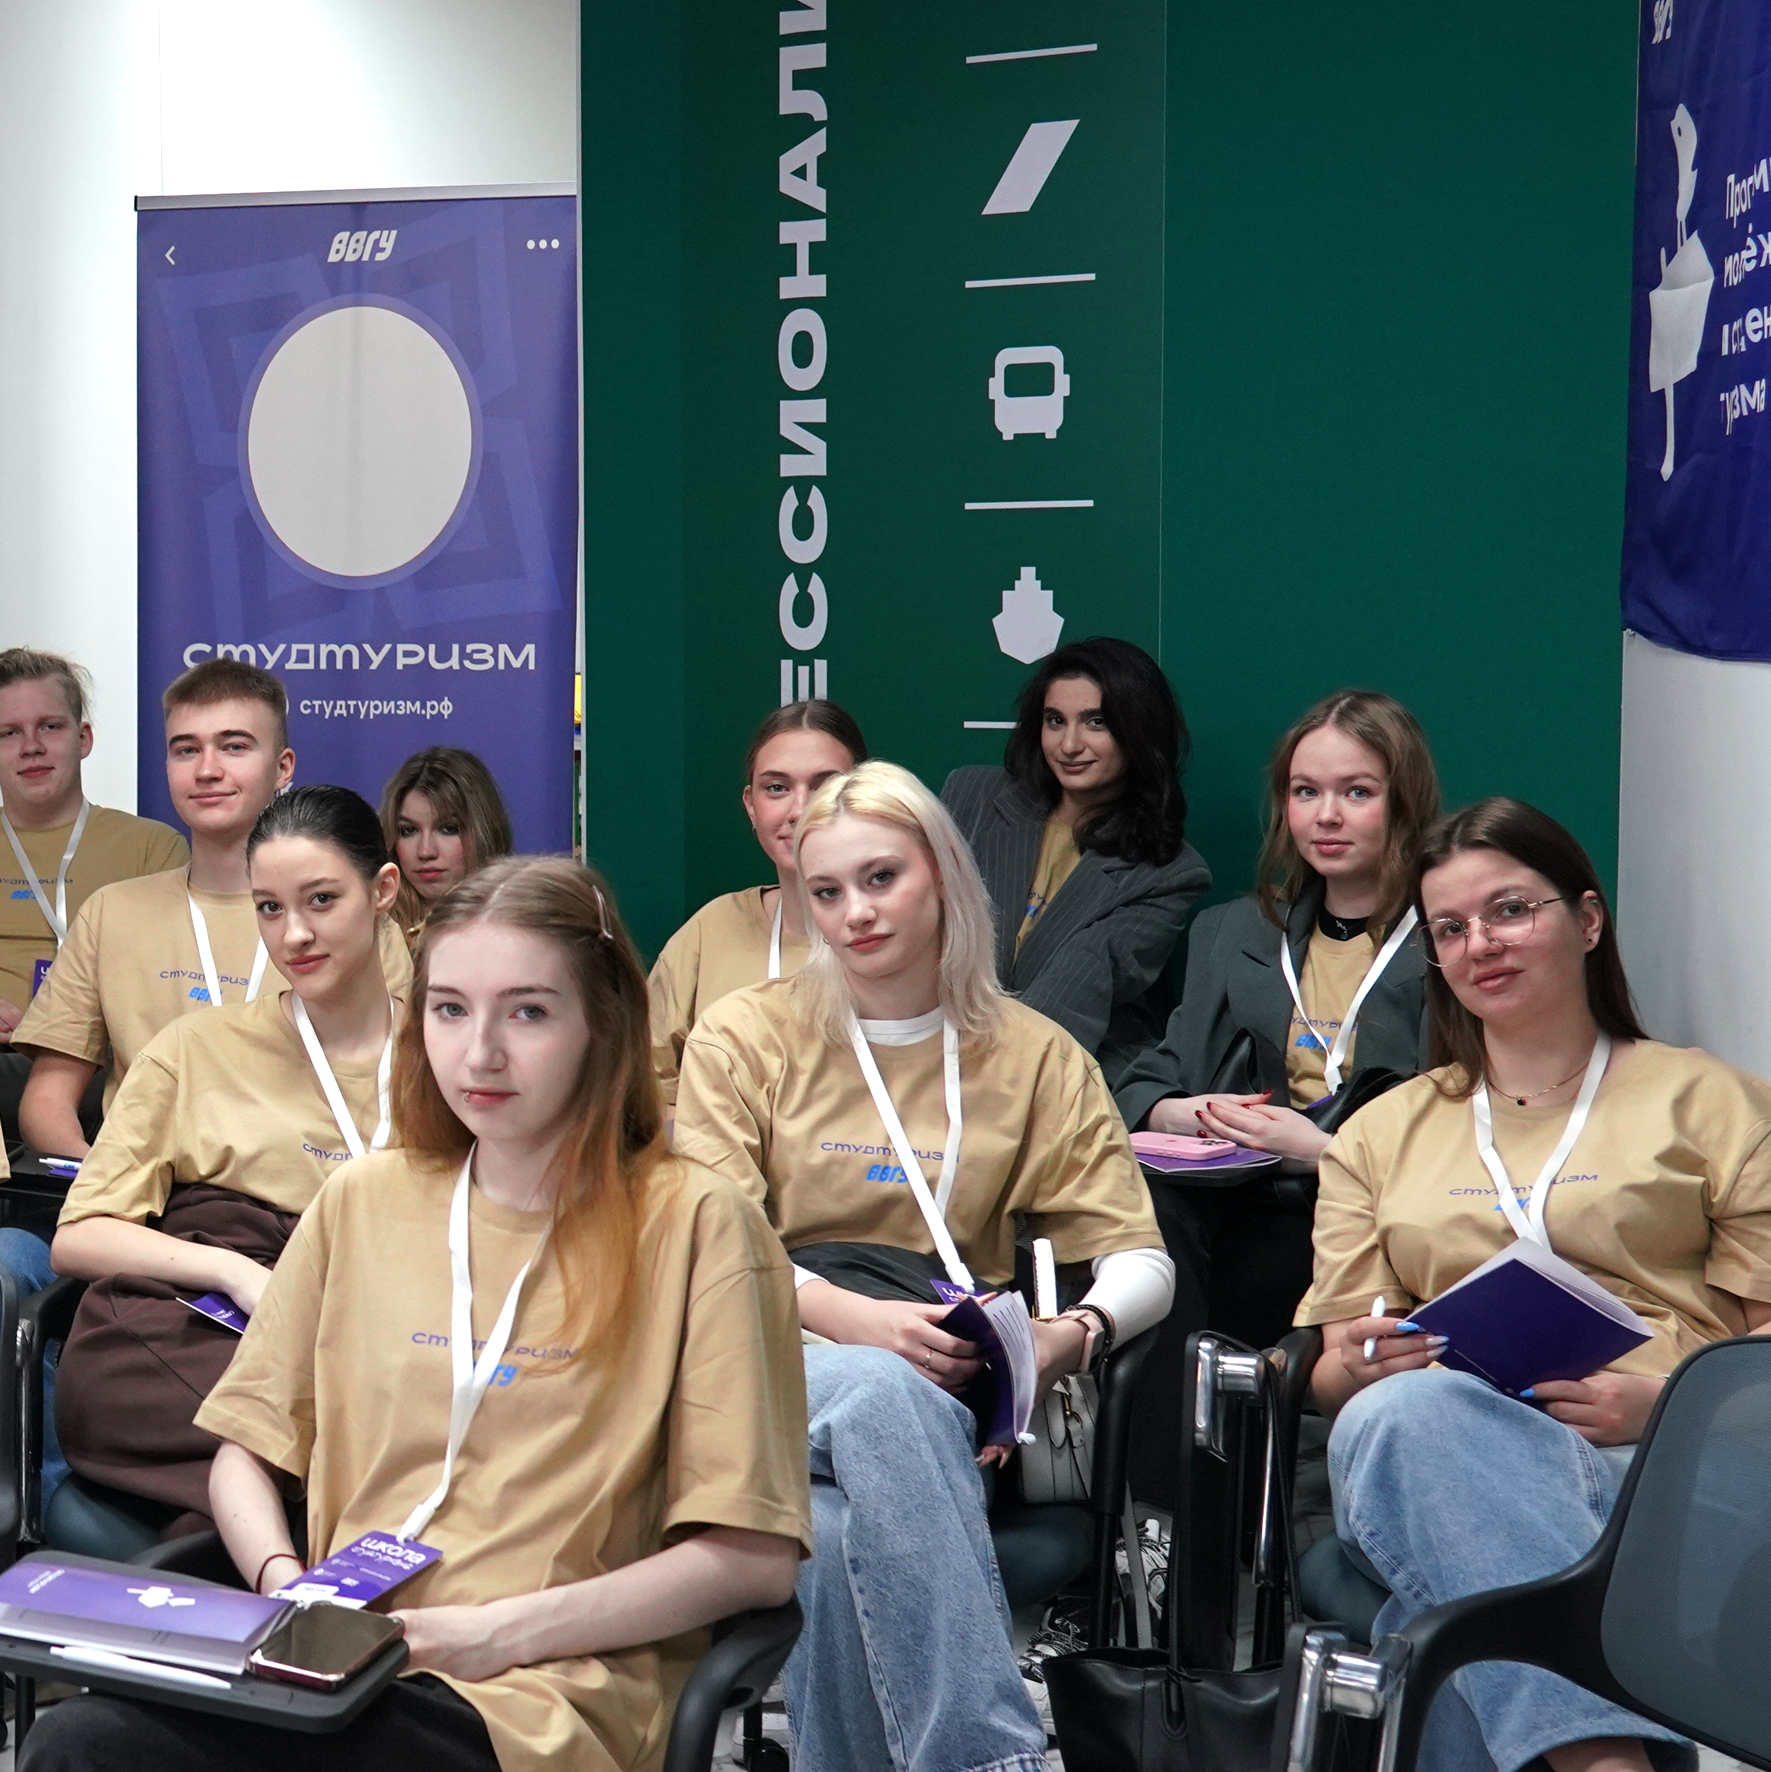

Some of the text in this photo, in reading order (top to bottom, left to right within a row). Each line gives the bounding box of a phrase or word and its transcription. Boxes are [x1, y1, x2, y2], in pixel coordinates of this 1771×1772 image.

[327, 229, 398, 263] ВВГУ
[299, 696, 454, 719] студтуризм.рф
[360, 1537, 427, 1565] школа
